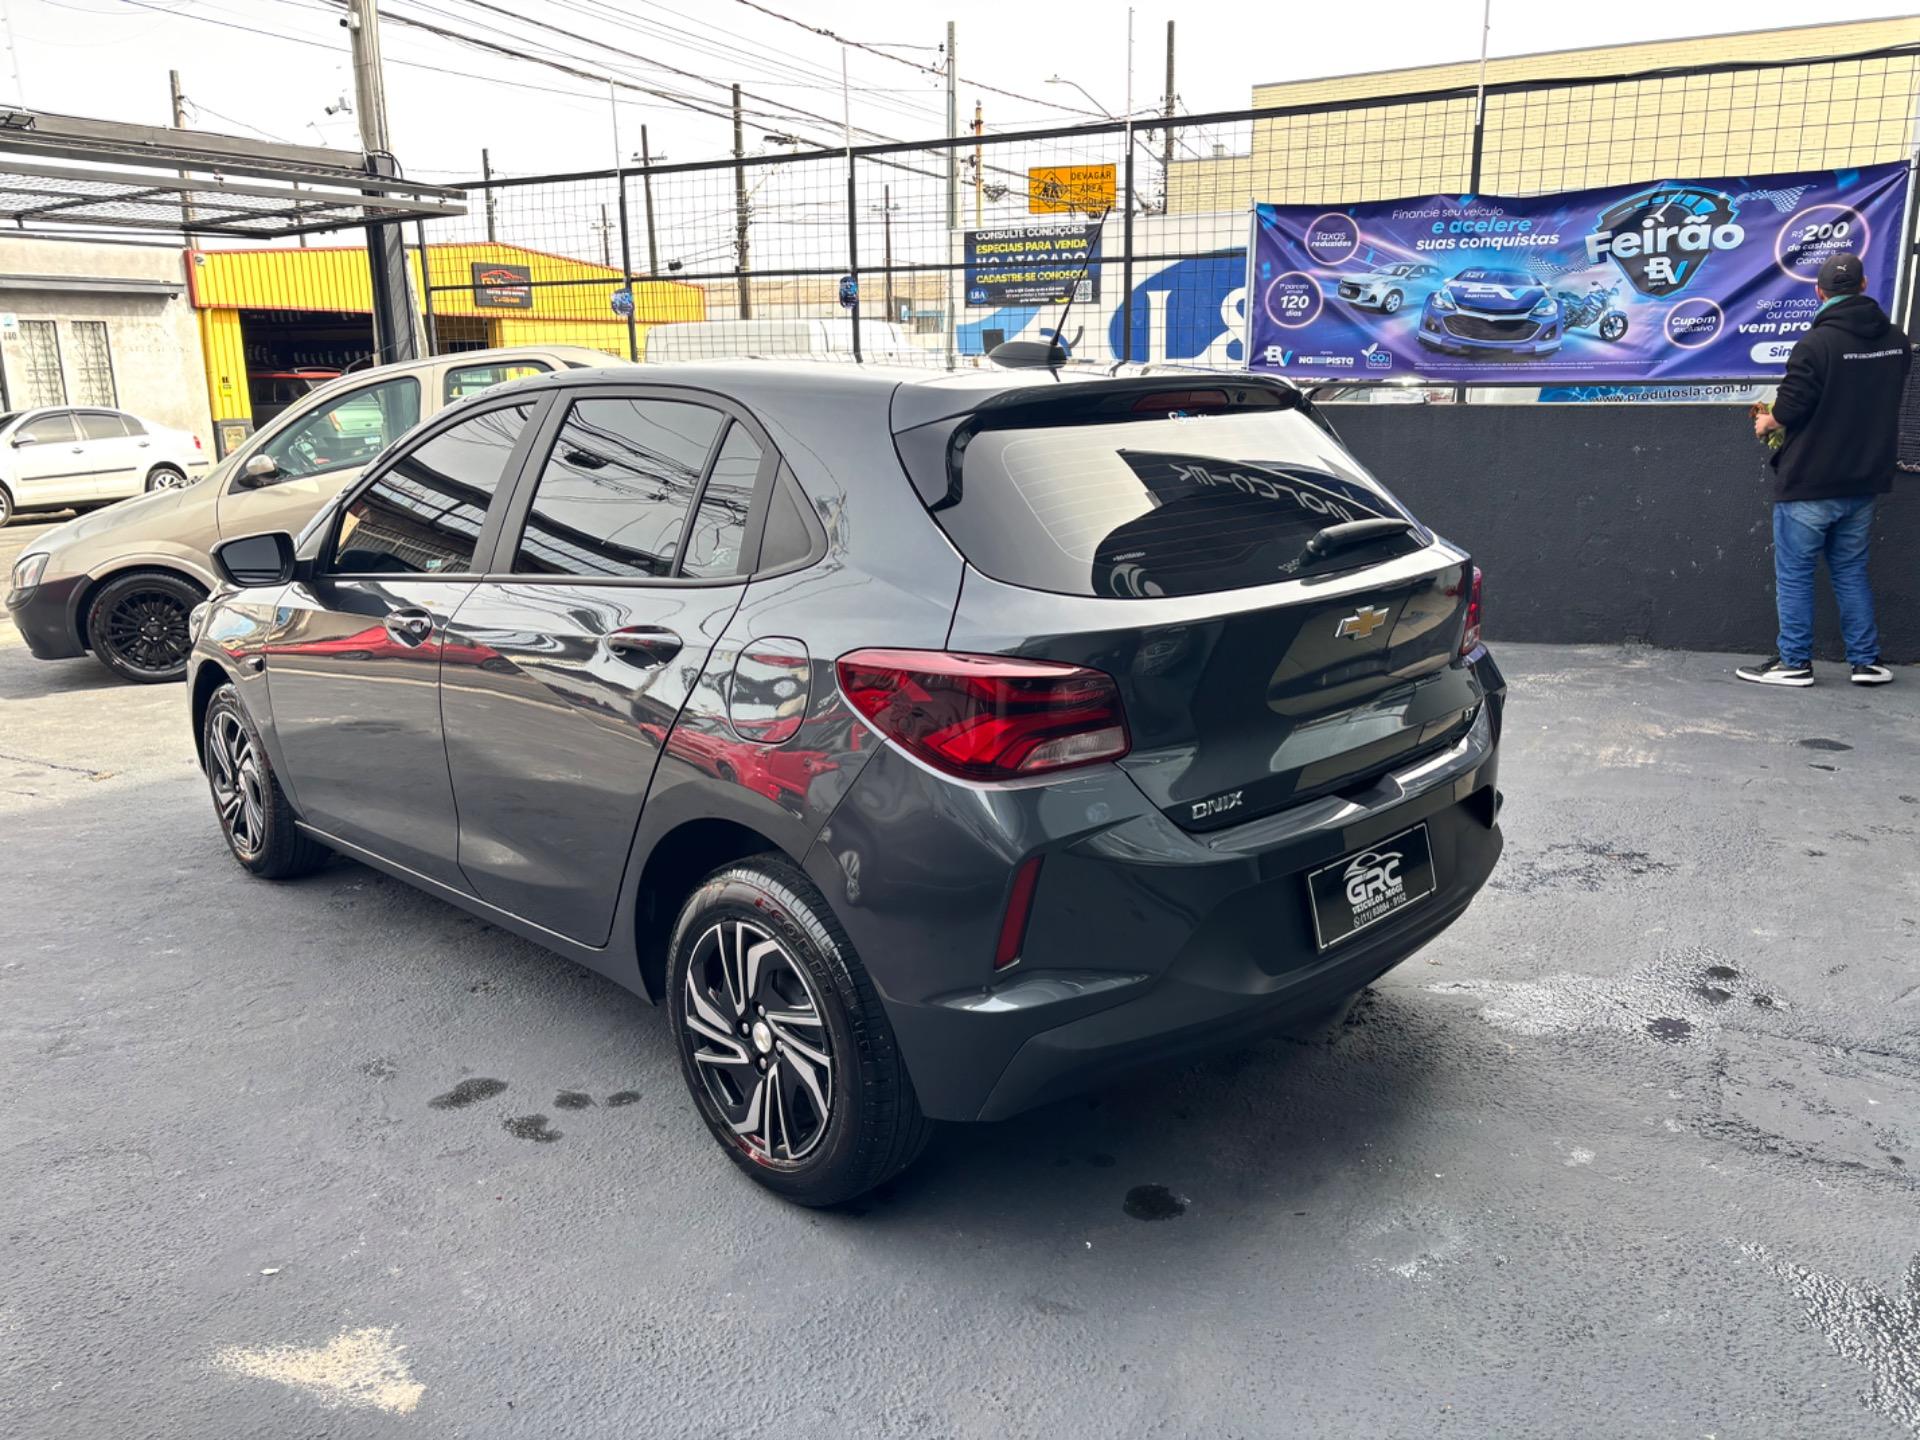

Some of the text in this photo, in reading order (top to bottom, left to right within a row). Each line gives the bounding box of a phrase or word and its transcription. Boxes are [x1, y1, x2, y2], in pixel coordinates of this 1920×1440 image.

[1071, 170, 1111, 180] DEVAGAR
[1392, 205, 1504, 220] Financie seu veículo
[1432, 217, 1533, 234] e acelere
[975, 229, 1025, 241] CONSULTE
[1316, 231, 1347, 240] Taxas
[1584, 214, 1745, 265] Feirão
[975, 238, 1089, 254] ESPECIAIS PARA VENDA
[1311, 239, 1352, 248] reduzidas
[1416, 233, 1561, 251] suas conquistas
[1787, 239, 1854, 252] de cashback
[1796, 257, 1826, 266] Conta
[975, 272, 1037, 284] CADASTRE-SE
[1280, 295, 1310, 309] 120
[1756, 299, 1781, 311] Seja
[1671, 315, 1716, 328] Cupom
[1766, 312, 1782, 320] ou
[1673, 325, 1714, 334] exclusivo
[1738, 321, 1812, 335] vem pro
[1191, 790, 1244, 820] ONIX
[1346, 859, 1402, 905] GRC
